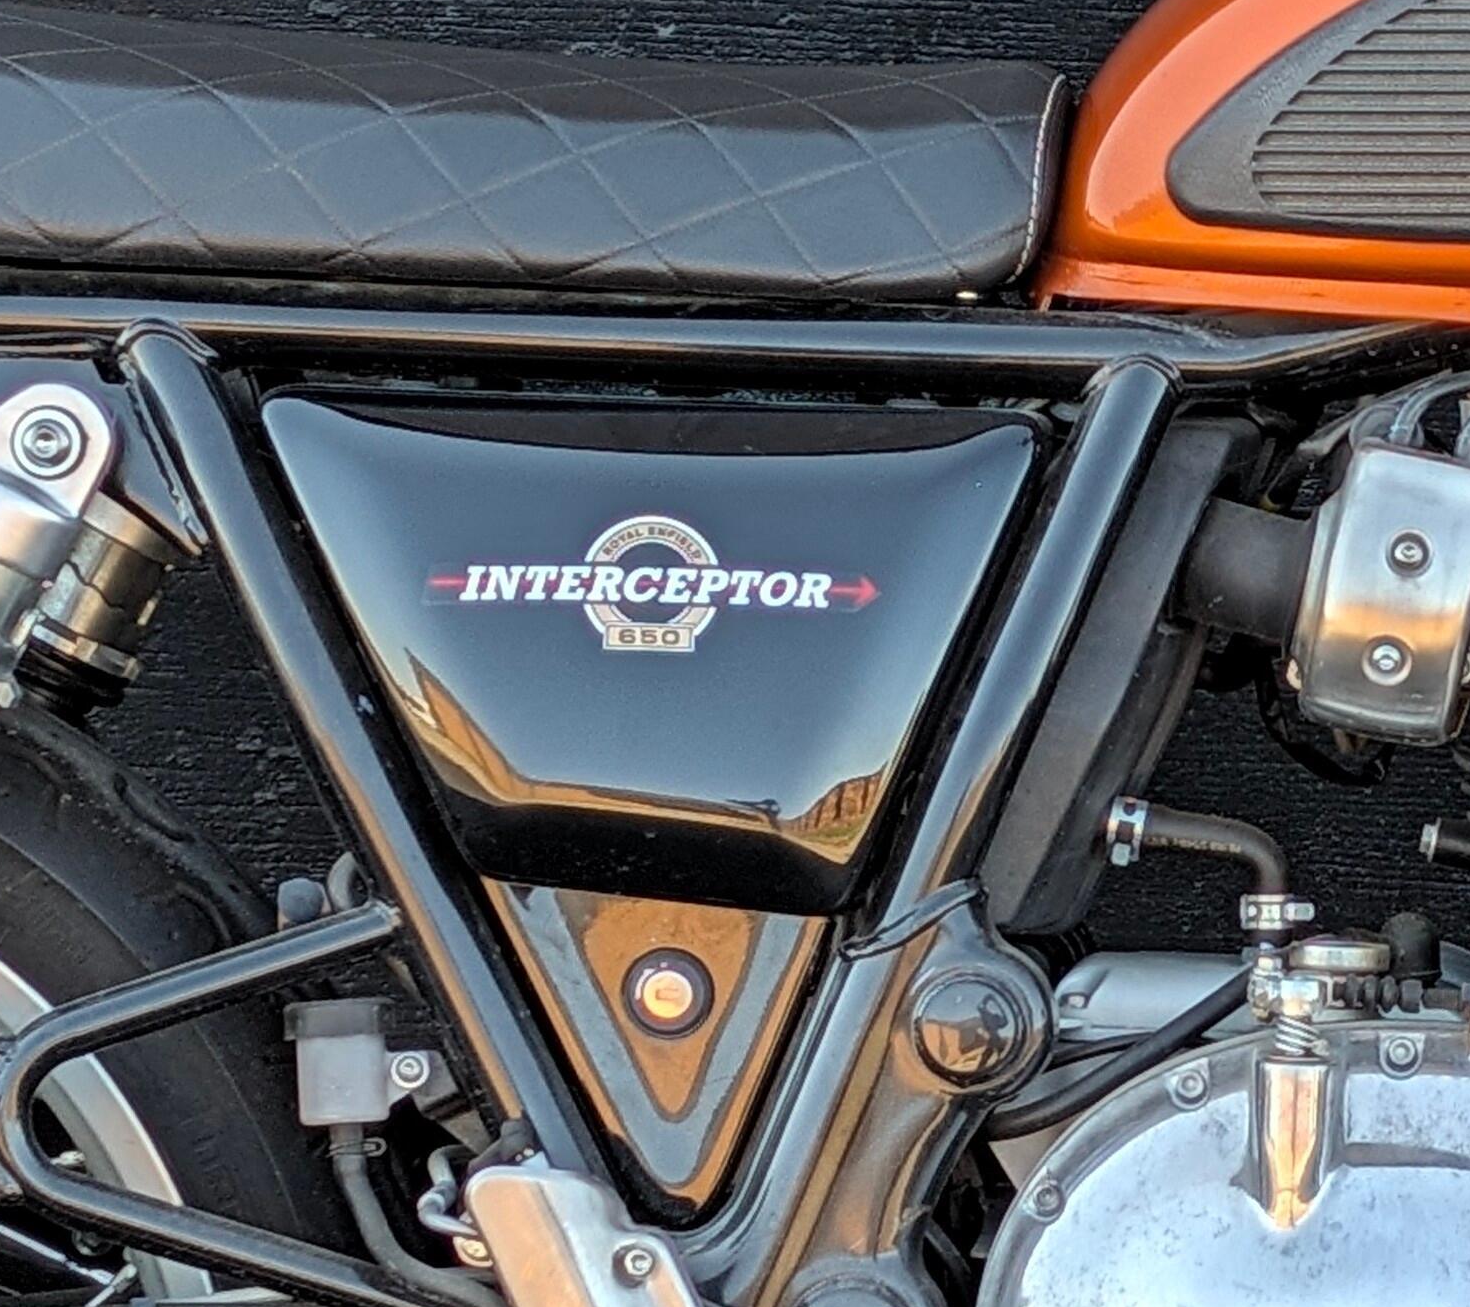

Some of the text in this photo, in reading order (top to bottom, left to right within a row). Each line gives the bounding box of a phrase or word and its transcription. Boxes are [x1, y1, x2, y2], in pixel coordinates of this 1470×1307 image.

[603, 527, 644, 556] ROYAL
[458, 565, 833, 610] INTERCEPTOR
[617, 627, 682, 647] 650
